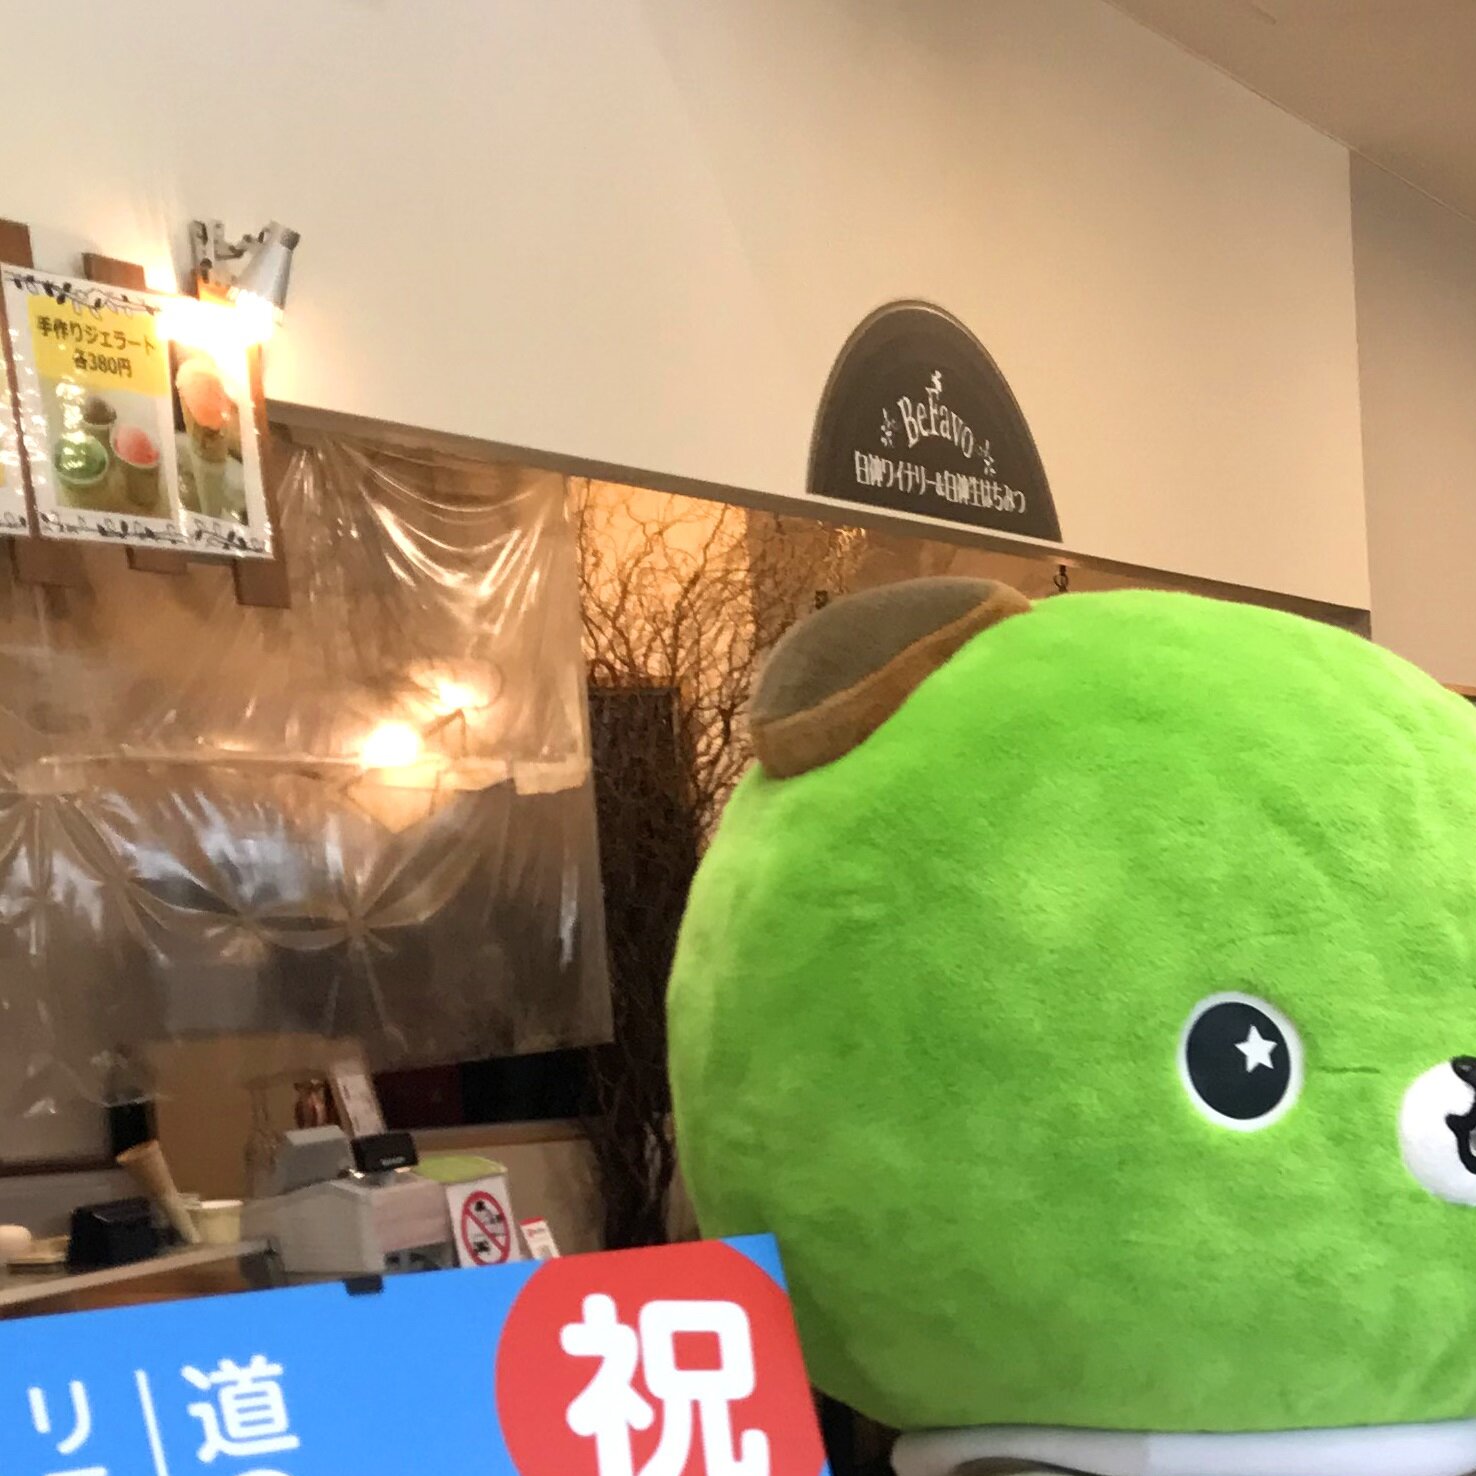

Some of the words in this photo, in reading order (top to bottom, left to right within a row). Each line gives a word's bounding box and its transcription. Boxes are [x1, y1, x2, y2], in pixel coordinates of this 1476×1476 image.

[36, 314, 156, 356] 手作りジェラート
[72, 347, 133, 378] 各380円
[896, 386, 974, 459] BeFavo
